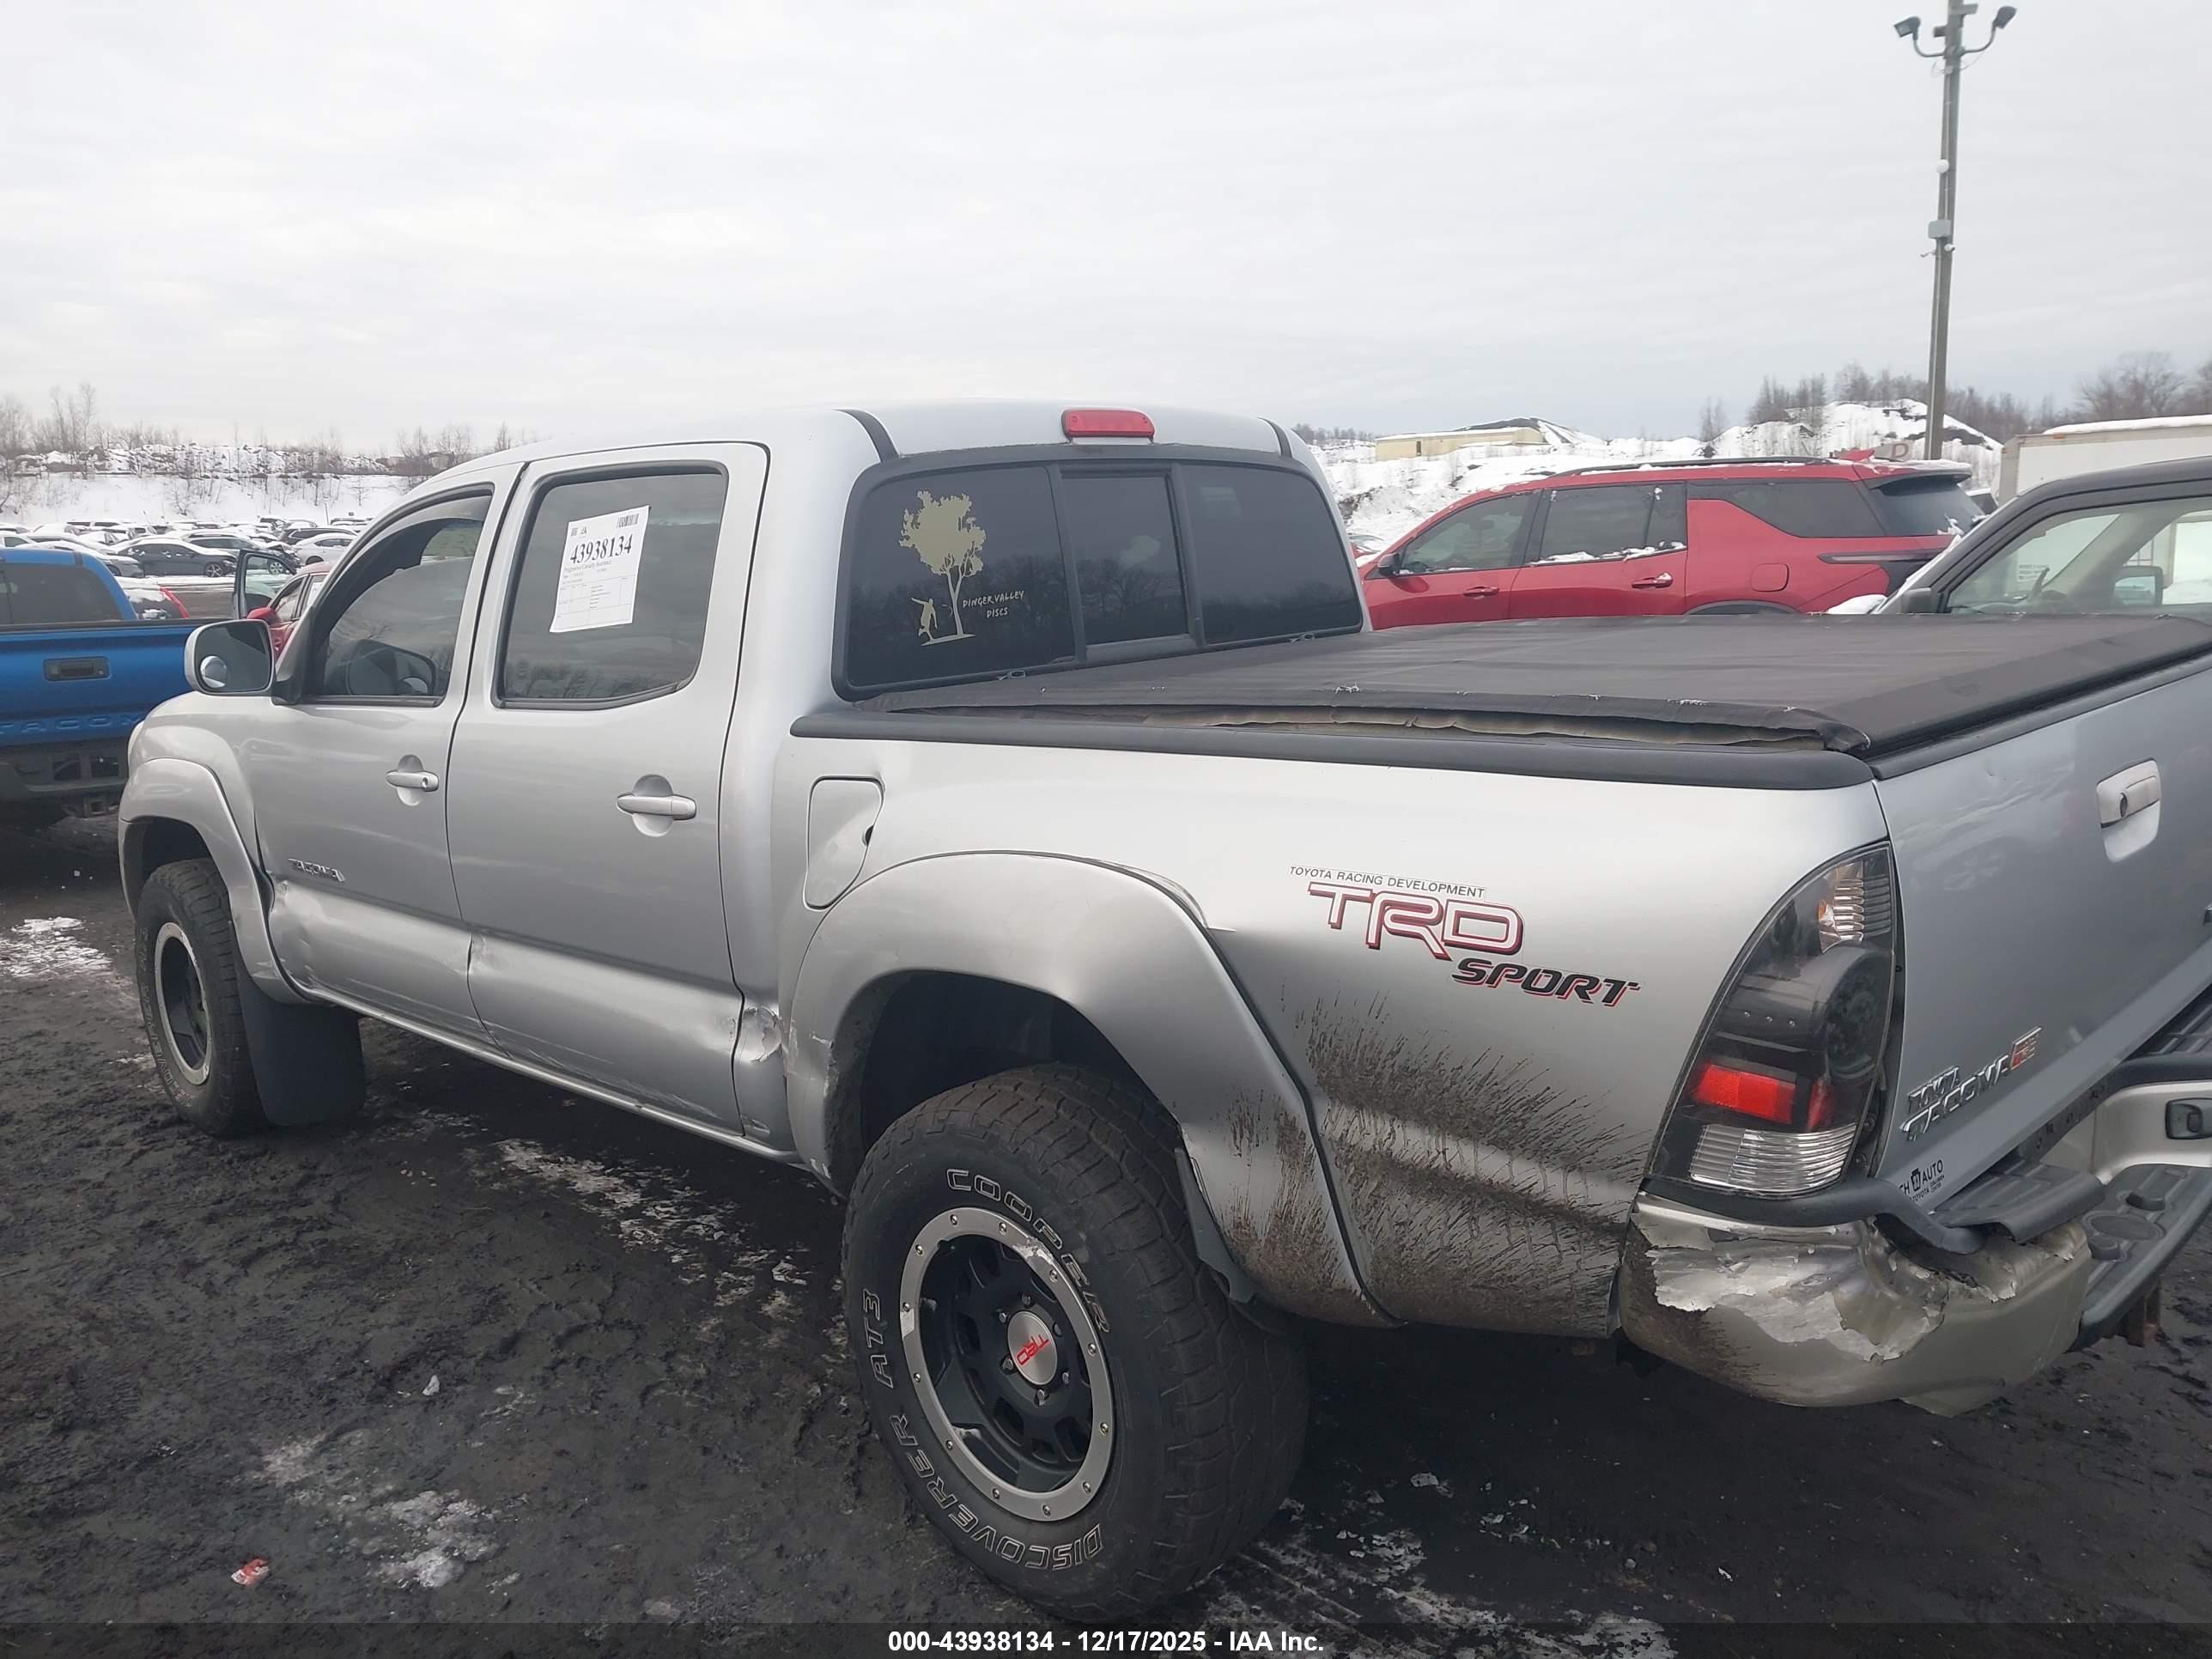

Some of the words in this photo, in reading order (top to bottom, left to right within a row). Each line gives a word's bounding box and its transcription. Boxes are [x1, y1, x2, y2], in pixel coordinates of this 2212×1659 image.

[569, 533, 633, 564] 43938134
[962, 595, 994, 608] DINGER
[994, 590, 1024, 602] VALLEY
[987, 606, 1008, 618] DISCS
[1289, 866, 1332, 879] TOYOTA
[1336, 871, 1383, 886] RACING
[1387, 877, 1486, 898] DEVELOPMENT
[1307, 881, 1524, 962] TRD
[1451, 957, 1641, 1007] SPORT
[1922, 1159, 1943, 1185] AUTO
[946, 1168, 1110, 1333] COOPER
[862, 1288, 894, 1389] AT3
[1016, 1334, 1050, 1366] TRD
[890, 1414, 1104, 1571] DISCOVERER
